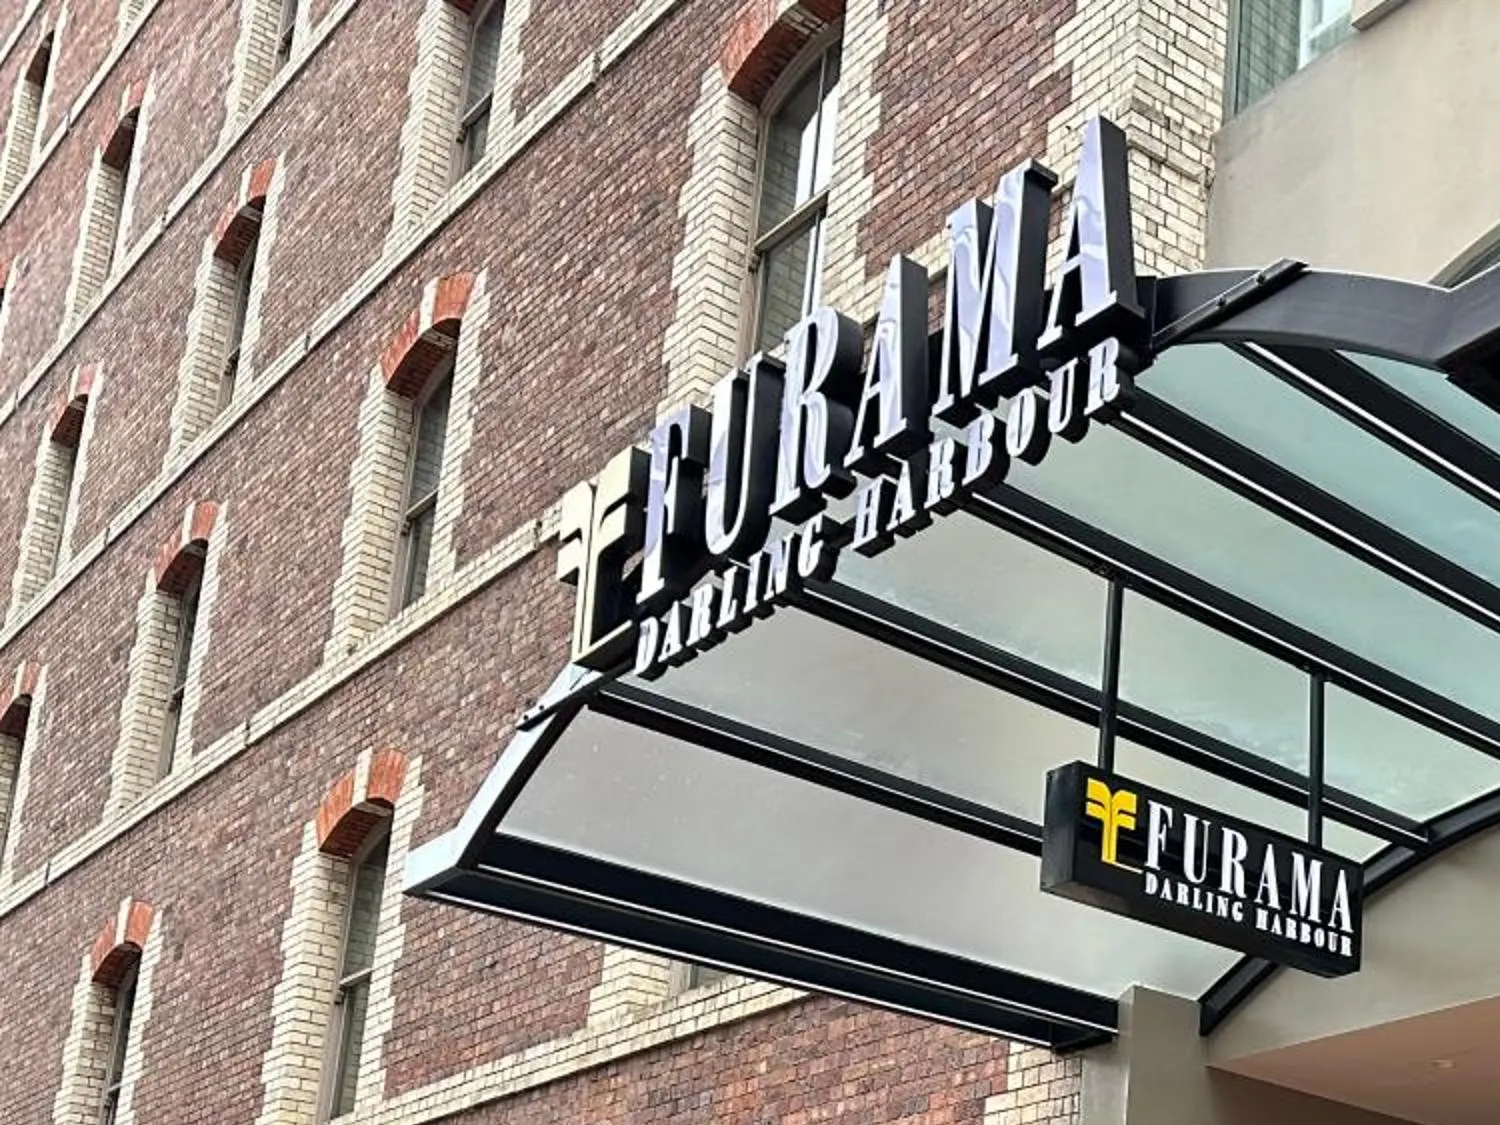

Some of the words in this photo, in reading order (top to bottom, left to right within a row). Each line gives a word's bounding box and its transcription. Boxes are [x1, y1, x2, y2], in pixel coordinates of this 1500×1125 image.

[636, 116, 1130, 604] FURAMA
[634, 517, 826, 676] DARLING
[853, 336, 1124, 552] HARBOUR
[1145, 800, 1355, 933] FURAMA
[1145, 873, 1244, 923] DARLING
[1255, 907, 1353, 957] HARBOUR
